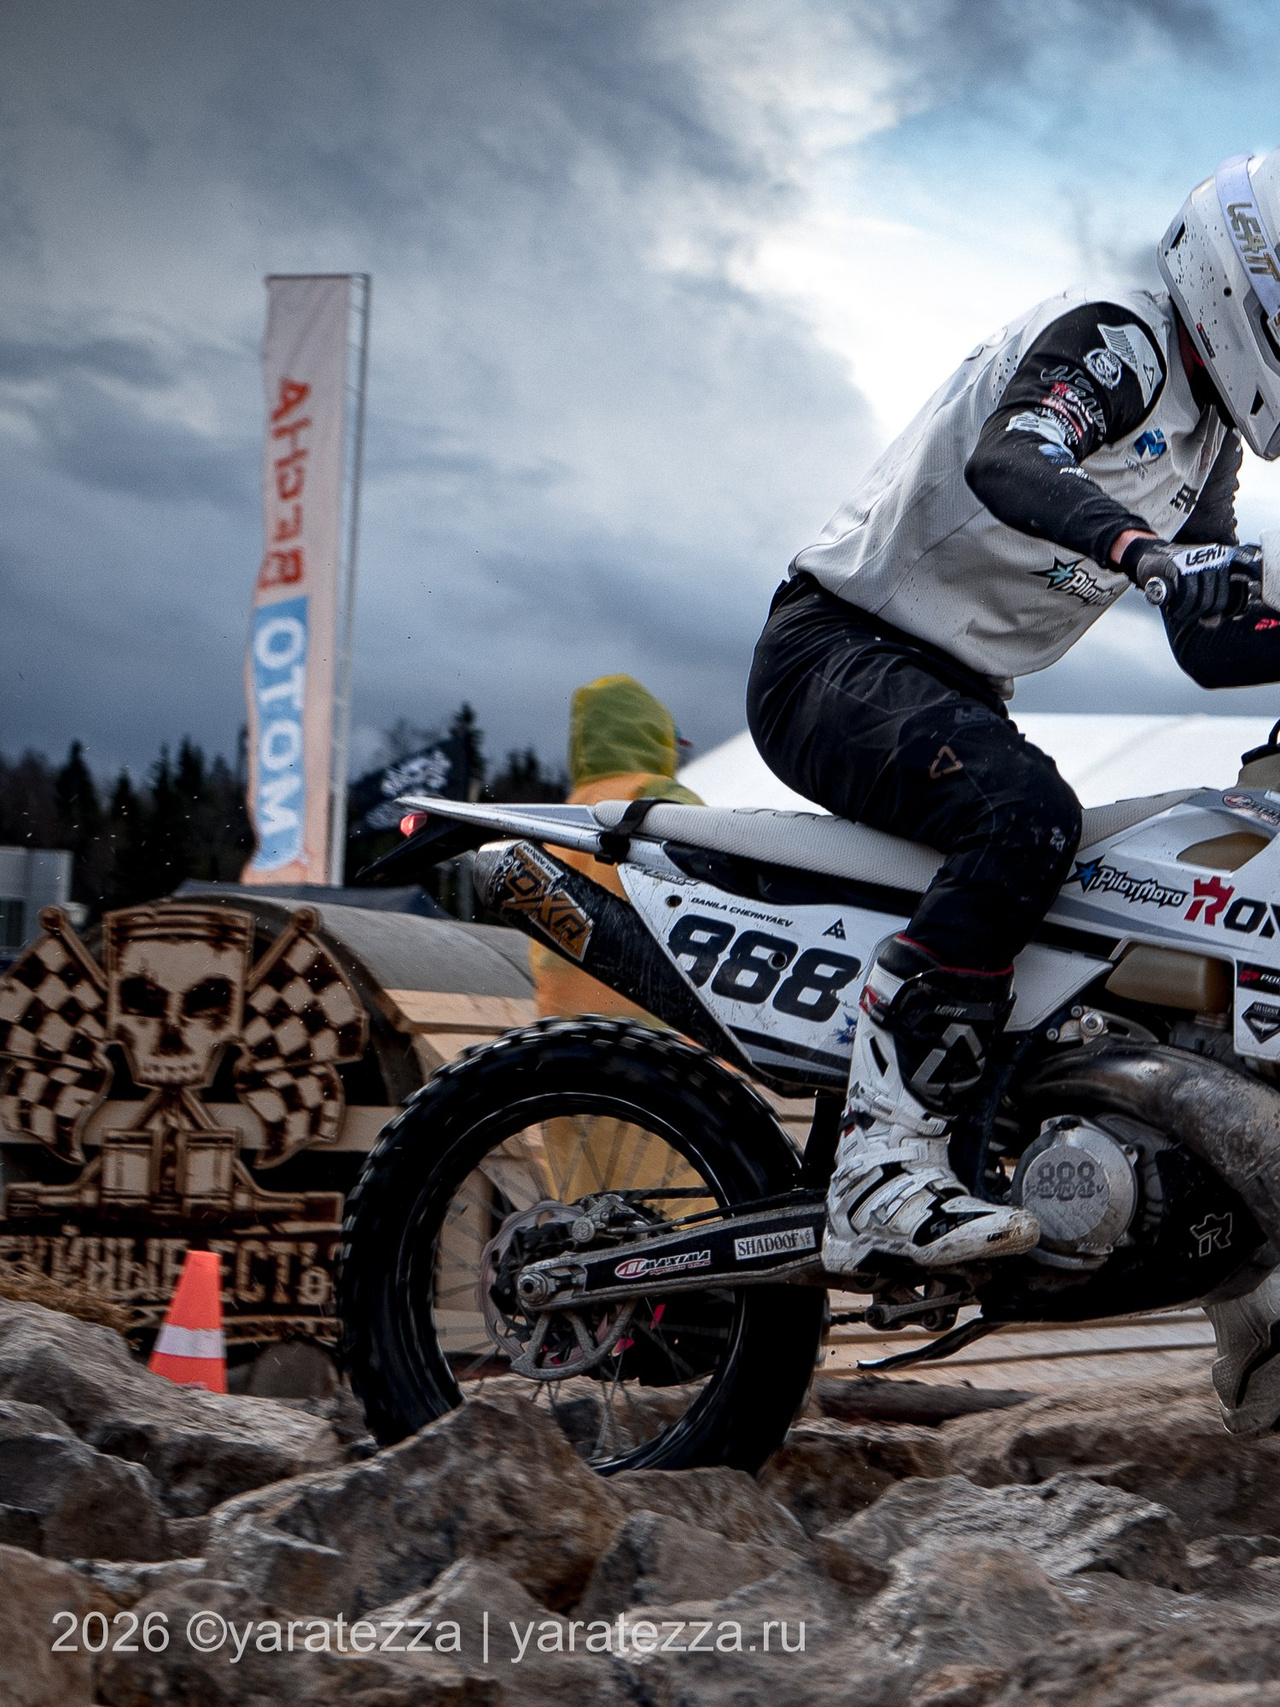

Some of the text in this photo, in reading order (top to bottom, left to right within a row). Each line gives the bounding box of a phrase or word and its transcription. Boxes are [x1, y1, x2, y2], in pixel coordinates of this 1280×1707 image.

[691, 896, 794, 929] DANILA CHERNYAEV
[667, 913, 862, 1023] 888
[934, 1004, 967, 1018] LEATT
[1037, 1160, 1096, 1201] 888
